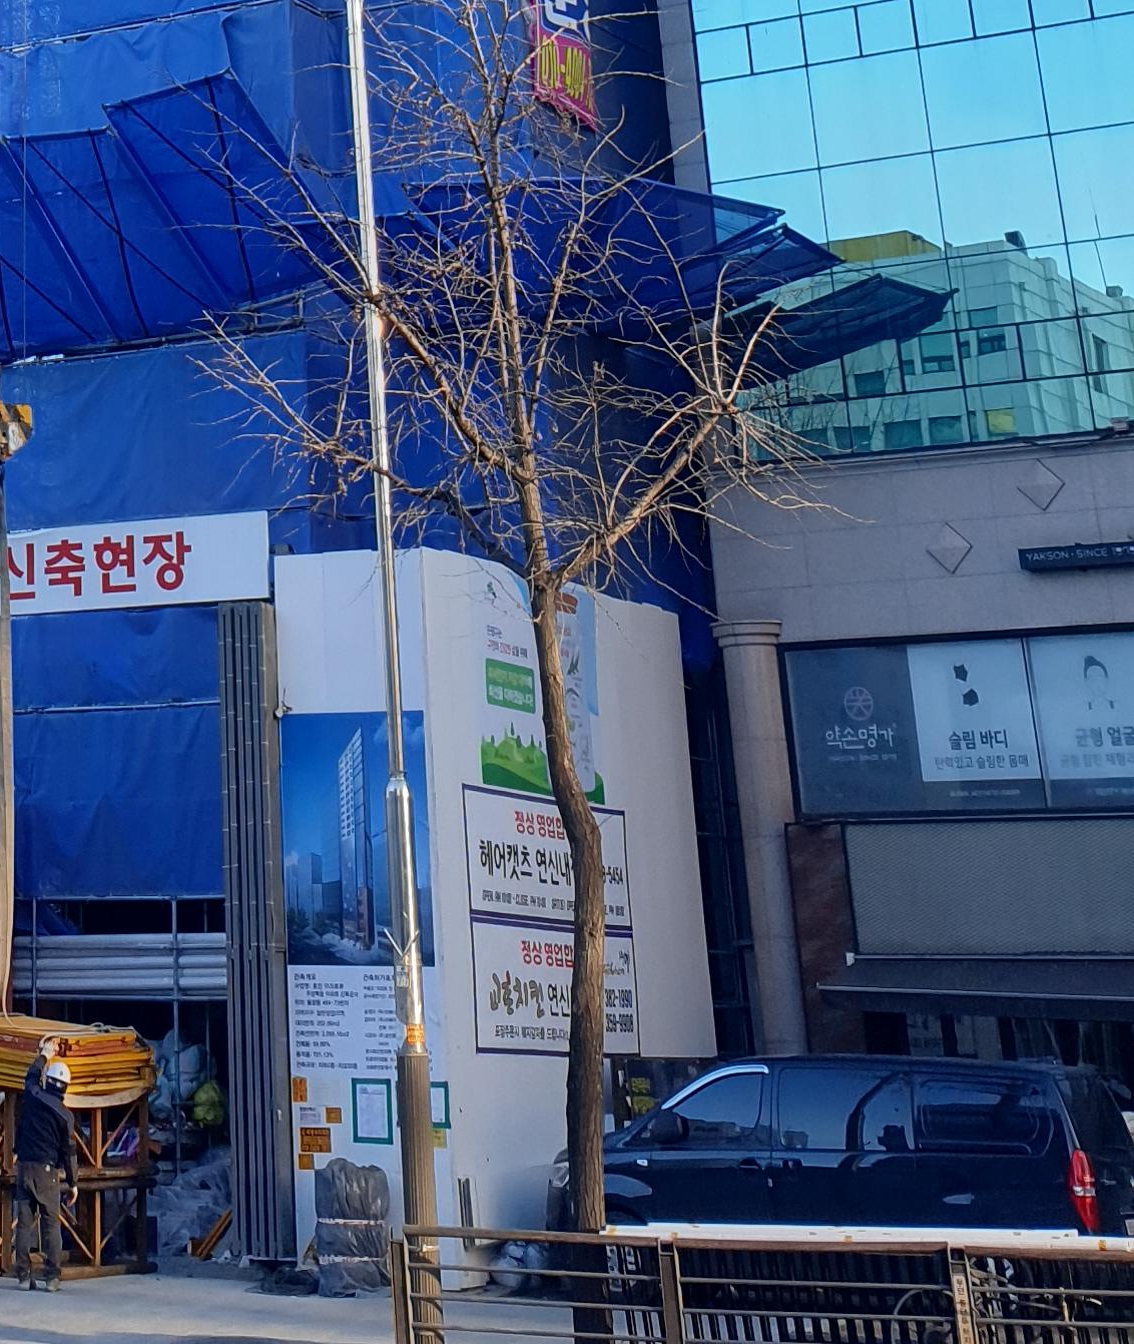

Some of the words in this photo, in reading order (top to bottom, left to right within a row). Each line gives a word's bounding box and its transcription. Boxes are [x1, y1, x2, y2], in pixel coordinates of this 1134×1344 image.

[7, 531, 192, 601] 신축현장
[1026, 550, 1069, 561] YAKSON
[1076, 548, 1107, 559] SINCE
[826, 724, 894, 750] 약손명가
[949, 728, 976, 750] 슬림
[980, 728, 1008, 749] 바디
[514, 811, 534, 836] 정상
[536, 814, 566, 841] 영업합
[479, 839, 533, 881] 헤어캣츠
[536, 848, 573, 887] 연신내
[521, 940, 543, 965] 정상
[544, 942, 574, 968] 영업합
